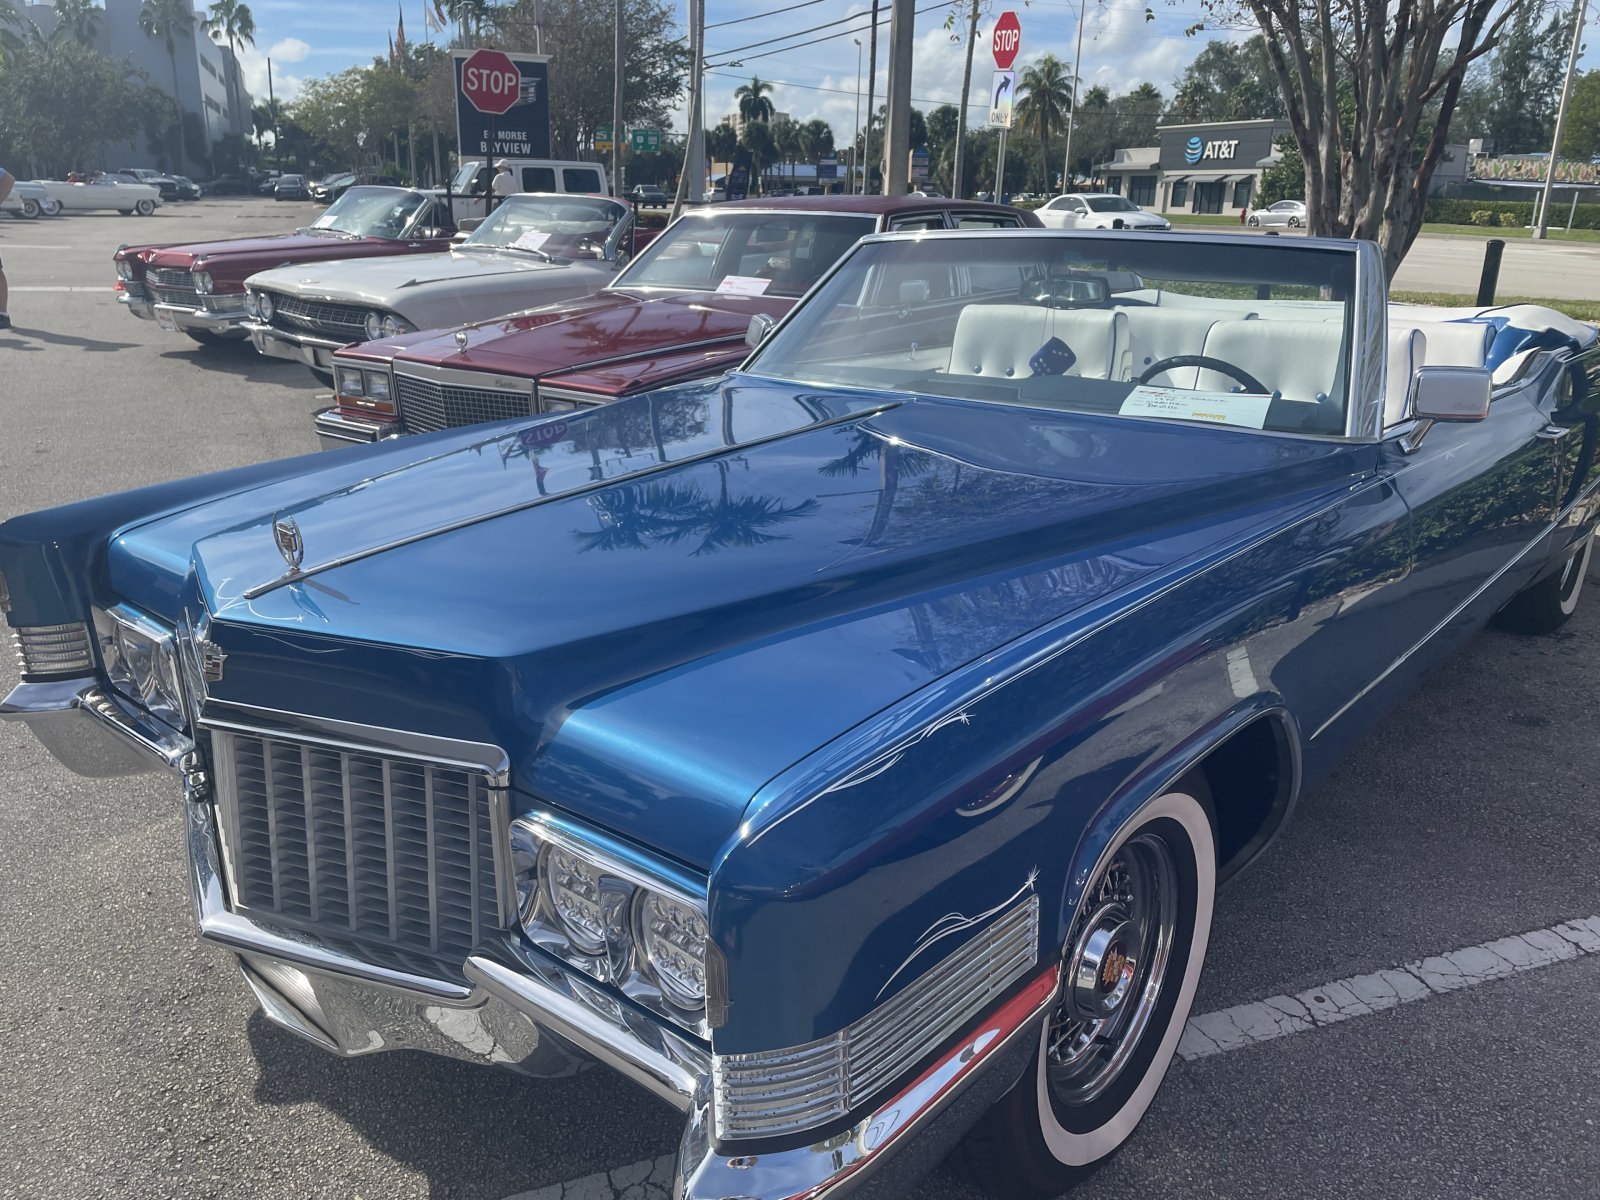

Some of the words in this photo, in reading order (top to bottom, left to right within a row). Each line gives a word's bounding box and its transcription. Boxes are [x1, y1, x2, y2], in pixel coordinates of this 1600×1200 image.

[994, 29, 1019, 51] STOP
[466, 67, 517, 95] STOP
[991, 111, 1008, 123] ONLY
[497, 130, 527, 141] MORSE
[1202, 140, 1239, 159] AT&T
